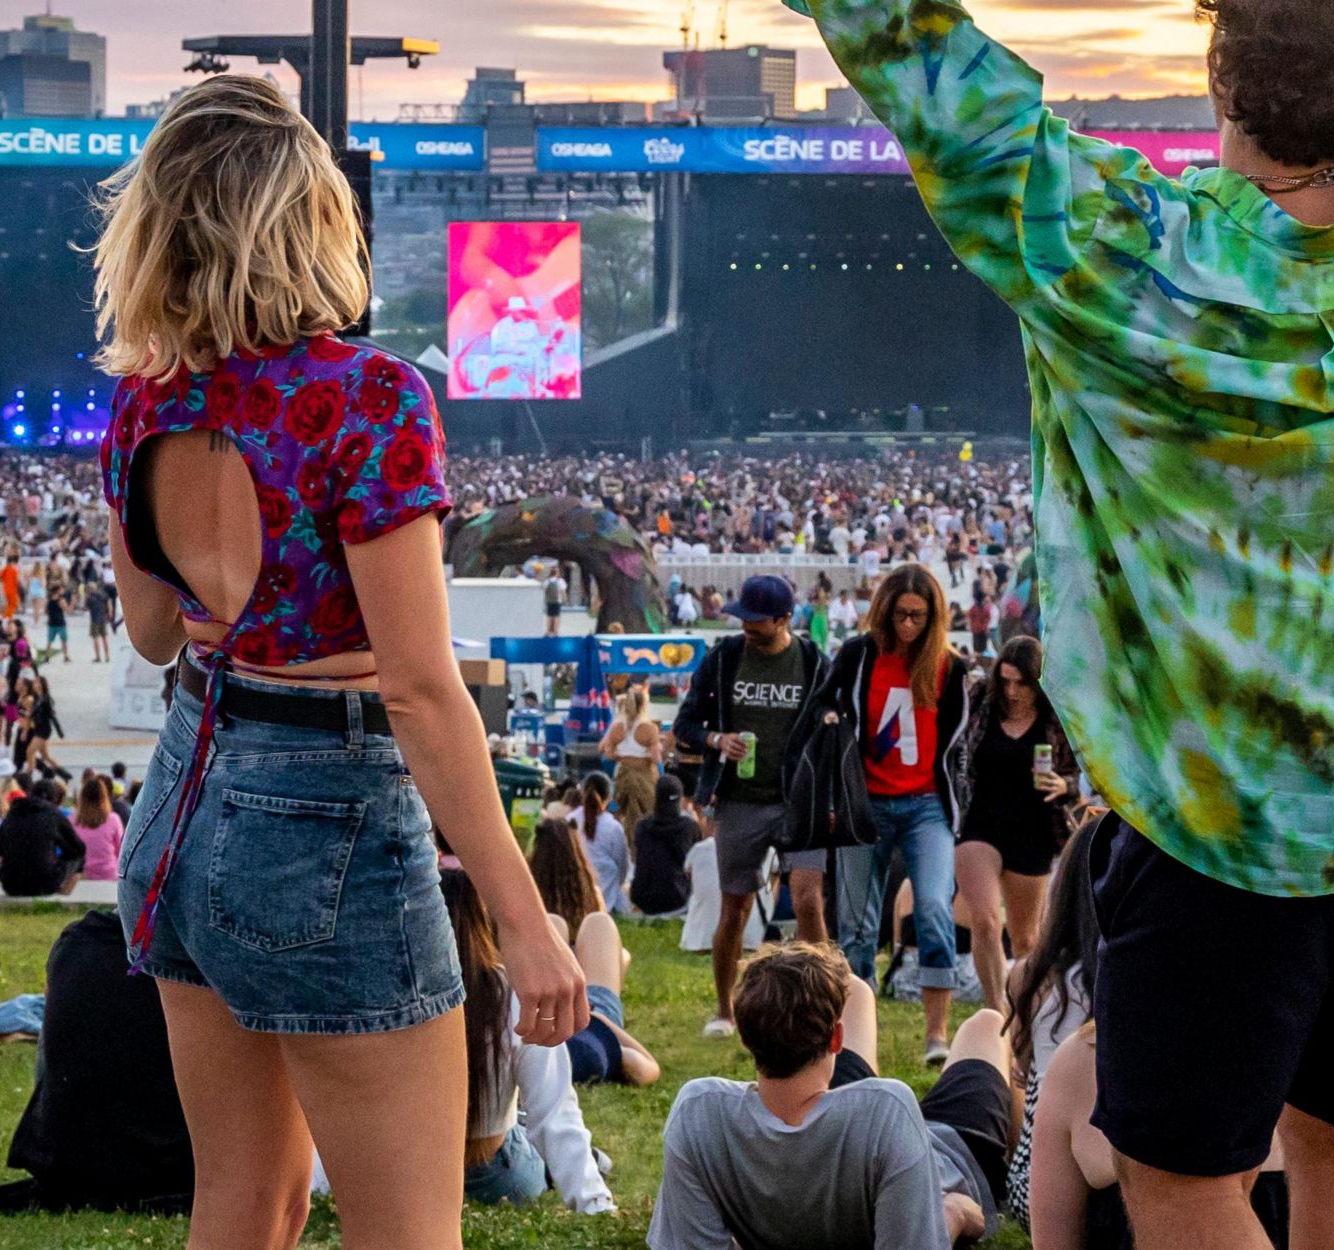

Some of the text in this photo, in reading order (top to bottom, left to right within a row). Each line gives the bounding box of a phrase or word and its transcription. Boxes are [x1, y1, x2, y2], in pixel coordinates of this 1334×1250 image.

[88, 132, 123, 155] DE
[129, 134, 145, 155] L
[830, 140, 863, 161] DE
[869, 141, 902, 161] LA
[732, 681, 803, 703] SCIENCE
